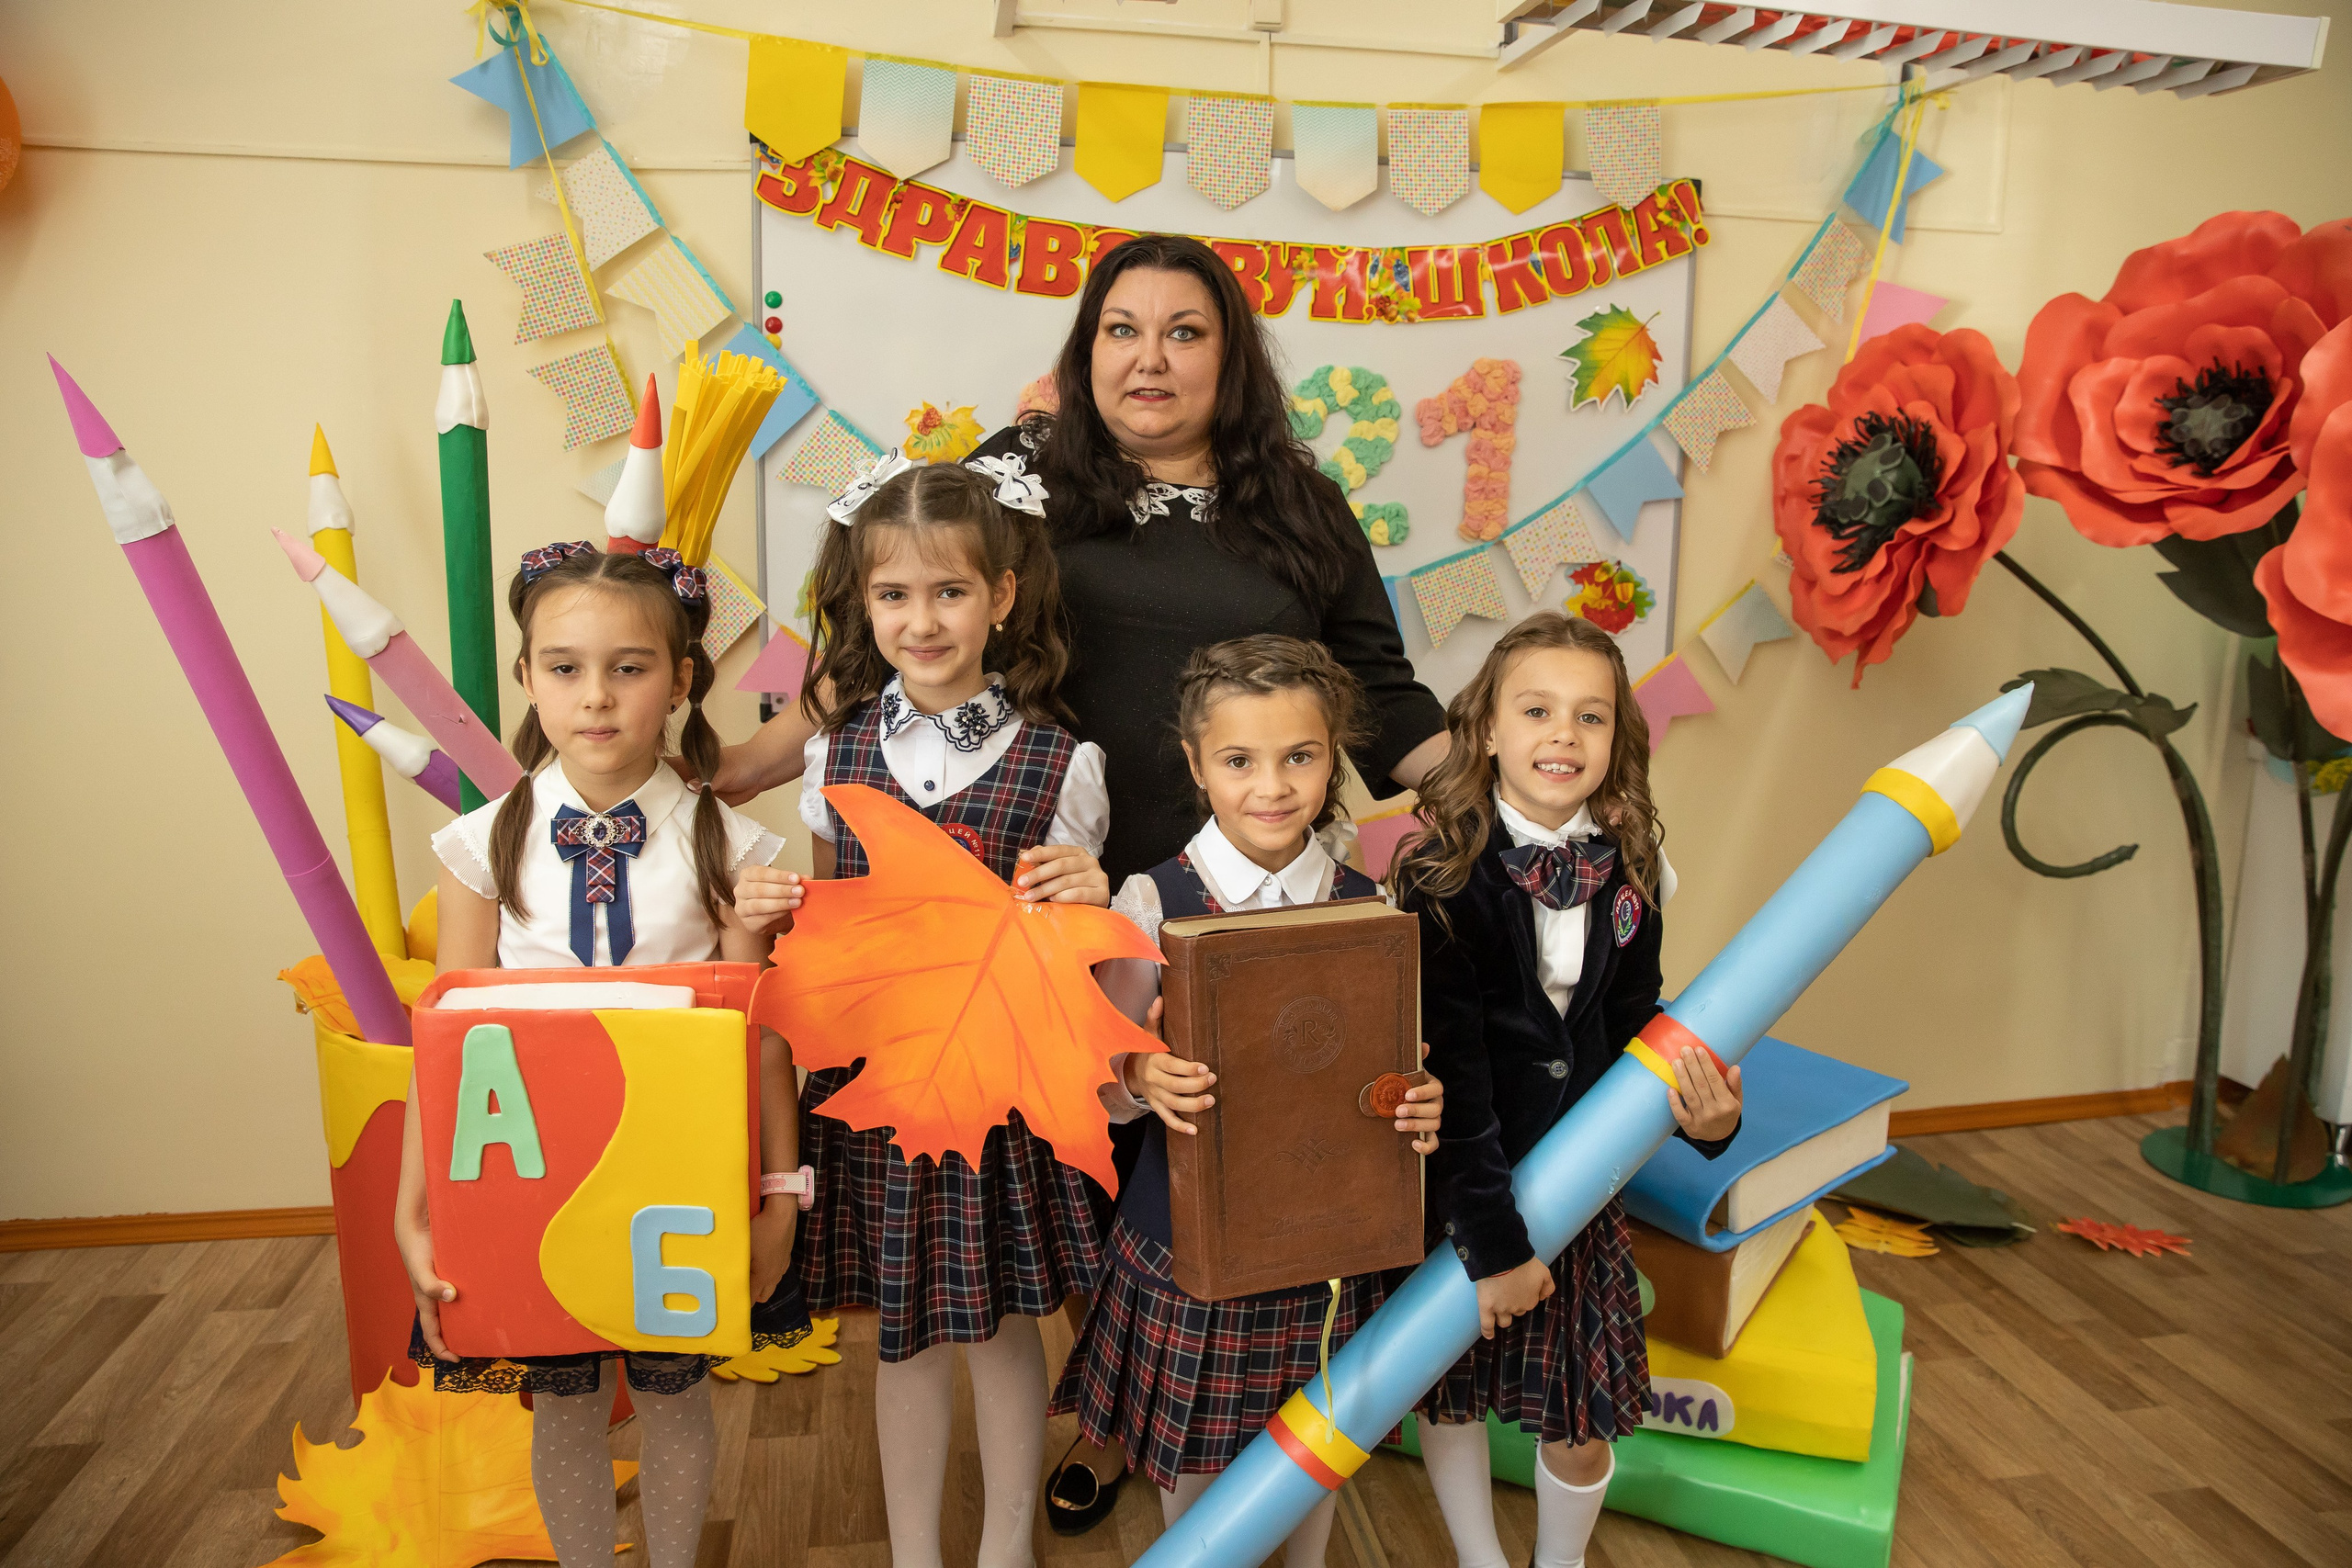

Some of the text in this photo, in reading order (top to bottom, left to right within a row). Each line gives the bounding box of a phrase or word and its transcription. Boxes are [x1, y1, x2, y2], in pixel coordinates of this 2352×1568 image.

[753, 145, 1711, 324] ЗДРАВВУЙ, ШКОЛА!
[449, 1023, 547, 1182] А
[1301, 1019, 1323, 1046] R
[630, 1204, 718, 1337] Б
